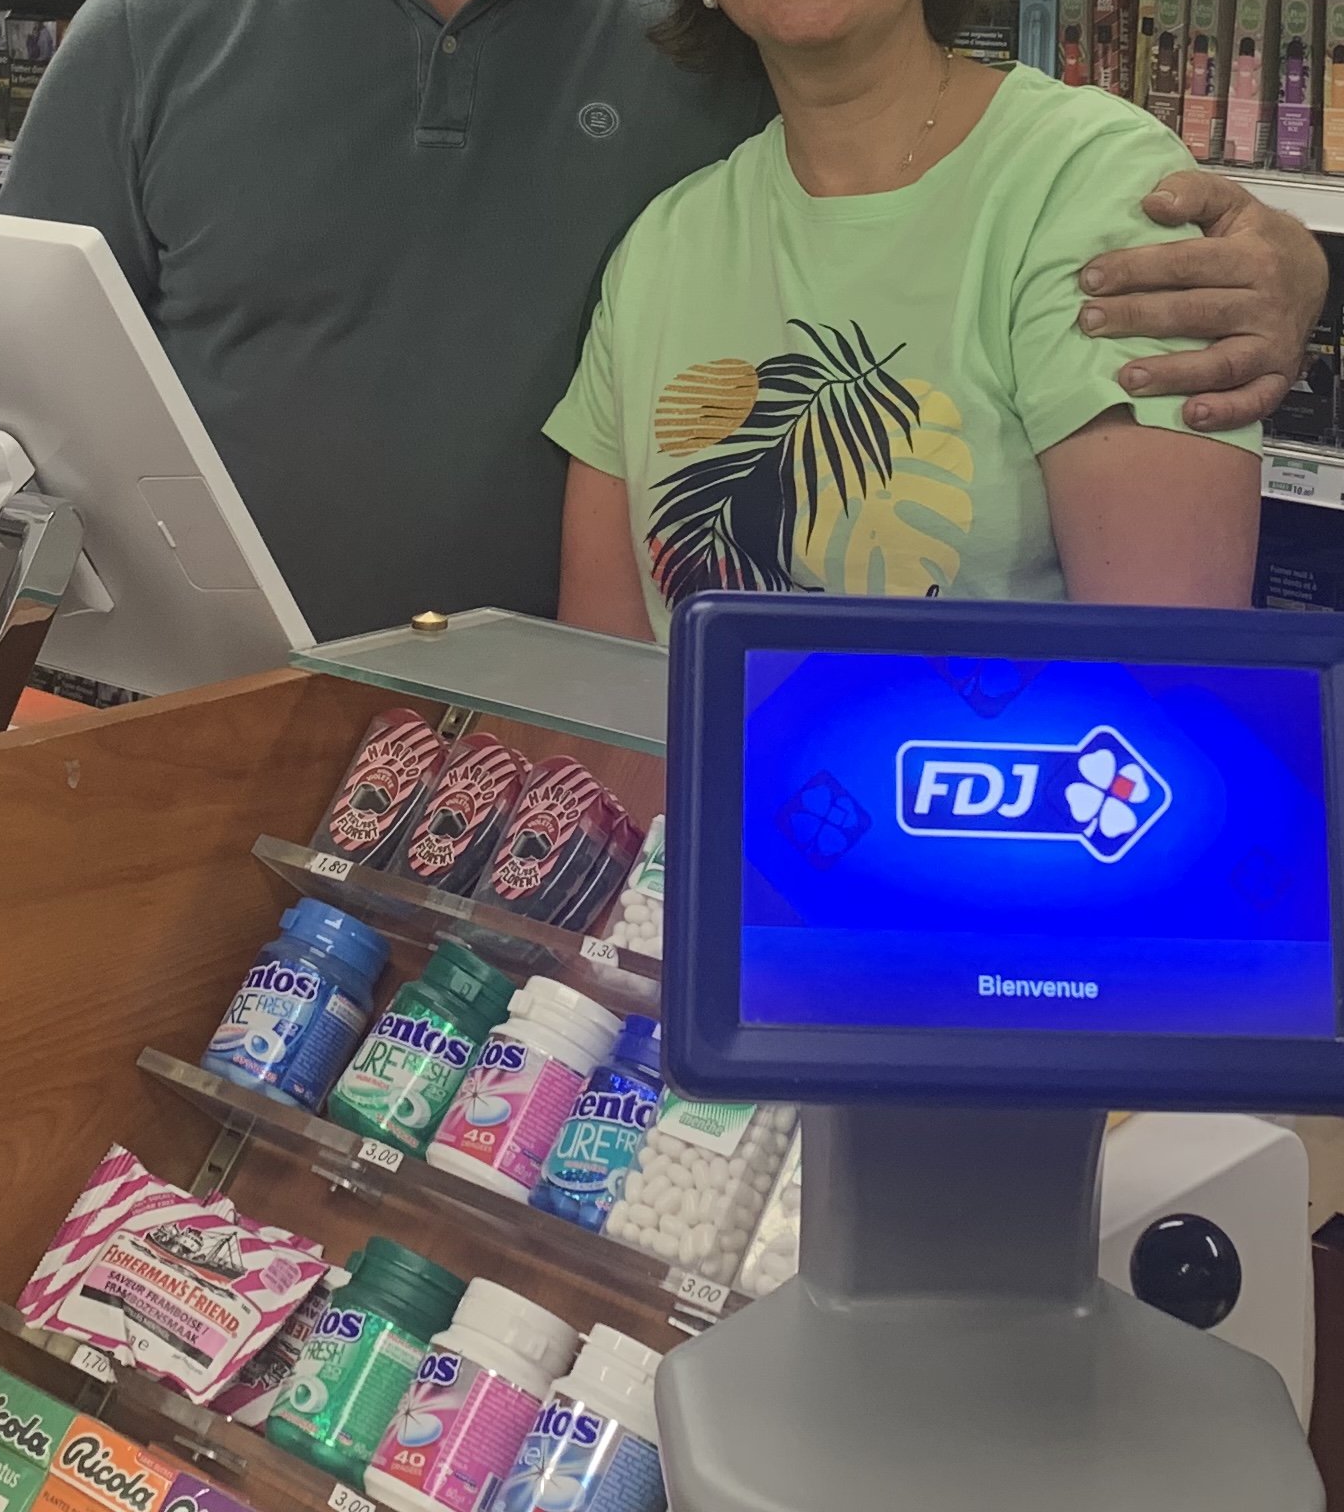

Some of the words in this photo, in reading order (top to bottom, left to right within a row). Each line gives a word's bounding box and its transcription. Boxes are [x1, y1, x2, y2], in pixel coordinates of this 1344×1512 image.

[366, 741, 420, 778] HARIBO
[449, 765, 496, 802] HARIBO
[914, 759, 1040, 819] FDJ
[528, 785, 581, 821] HARIBO
[336, 817, 379, 840] FLORENT
[318, 856, 349, 876] 1,80
[415, 843, 454, 867] FLORENT
[498, 867, 541, 888] FLORENT
[585, 940, 617, 960] 1,30
[242, 964, 319, 1002] ntos
[977, 974, 1098, 999] Bienvenue
[376, 1012, 472, 1069] entos
[462, 1127, 497, 1147] 40
[677, 1107, 726, 1138] menthe
[365, 1143, 399, 1165] 3,00
[101, 1244, 187, 1301] FISHERMAN'S
[184, 1286, 239, 1333] FRIEND
[107, 1270, 146, 1294] SAVEUR
[146, 1290, 202, 1332] FRAMBOISE
[681, 1277, 723, 1304] 3,00
[104, 1281, 200, 1345] FRAMBOZENSMAAK
[80, 1350, 108, 1373] 1,70
[534, 1401, 600, 1445] ntos
[64, 1435, 156, 1512] Ricola
[394, 1450, 426, 1468] 40
